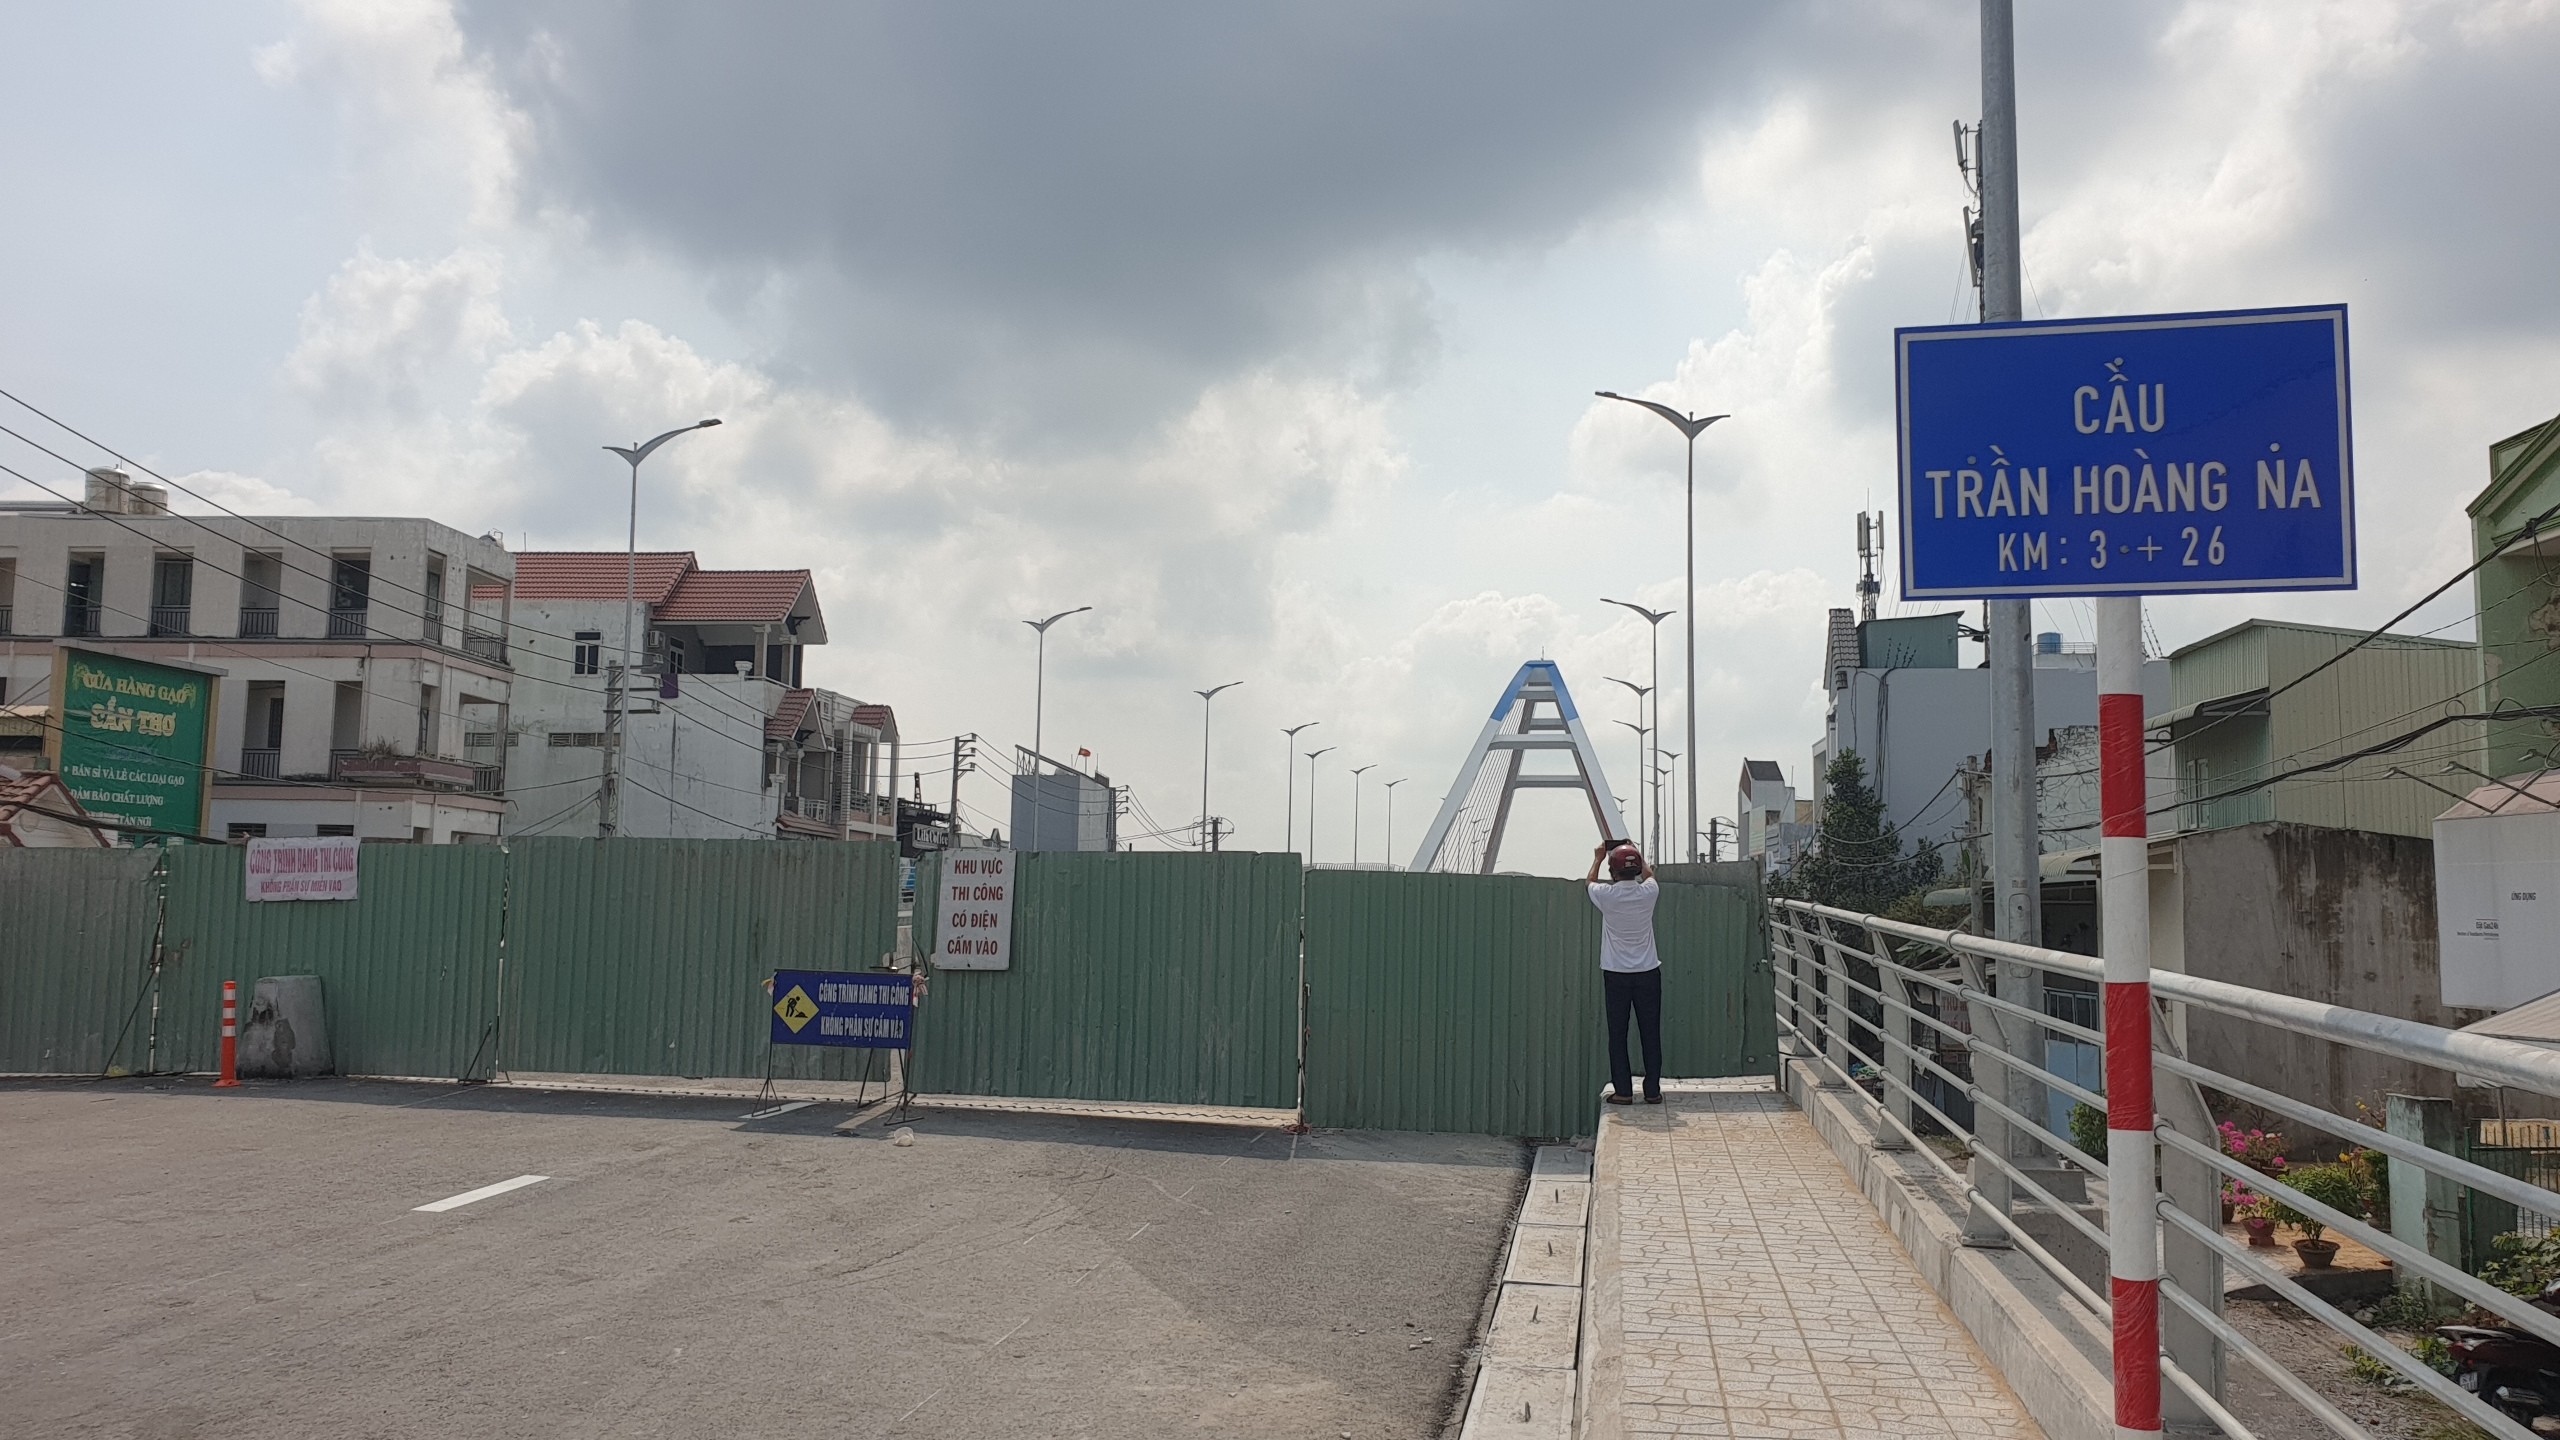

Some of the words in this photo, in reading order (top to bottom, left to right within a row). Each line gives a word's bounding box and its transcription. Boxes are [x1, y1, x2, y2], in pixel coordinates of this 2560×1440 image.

[2074, 361, 2165, 434] CẦU
[1926, 444, 2048, 518] TRẦN
[2074, 448, 2227, 515] HOÀNG
[2258, 458, 2321, 510] NA
[2090, 530, 2108, 569] 3
[2182, 526, 2225, 566] 26
[116, 676, 155, 699] HÀNG
[158, 687, 187, 704] GẠO
[137, 710, 176, 737] THƠ
[71, 763, 92, 777] BÁN
[103, 767, 115, 779] VÀ
[128, 769, 147, 782] CÁC
[147, 774, 167, 787] LOẠI
[167, 775, 185, 787] GẠO
[92, 788, 110, 801] BẢO
[111, 790, 135, 804] CHẤT
[136, 794, 164, 807] LƯỢNG
[250, 843, 272, 874] CÔNG
[273, 842, 296, 873] TRÌNH
[320, 847, 332, 873] THI
[333, 841, 354, 872] CÔNG
[954, 860, 977, 874] KHU
[981, 857, 1003, 878] VỰC
[260, 878, 282, 893] KHÔNG
[951, 886, 970, 901] THI
[973, 883, 1003, 901] CÔNG
[952, 909, 967, 928] CÓ
[971, 910, 998, 931] ĐIỆN
[947, 935, 972, 954] CẤM
[976, 937, 998, 955] VÀO
[818, 979, 838, 1002] CÔNG
[838, 980, 859, 1003] TRÌNH
[878, 985, 890, 1005] THI
[890, 982, 910, 1006] CÔNG
[821, 1012, 844, 1036] KHÔNG
[844, 1013, 863, 1041] PHẬN
[864, 1016, 874, 1042] SỰ
[874, 1012, 890, 1038] CẤM
[890, 1016, 904, 1039] VÀO
